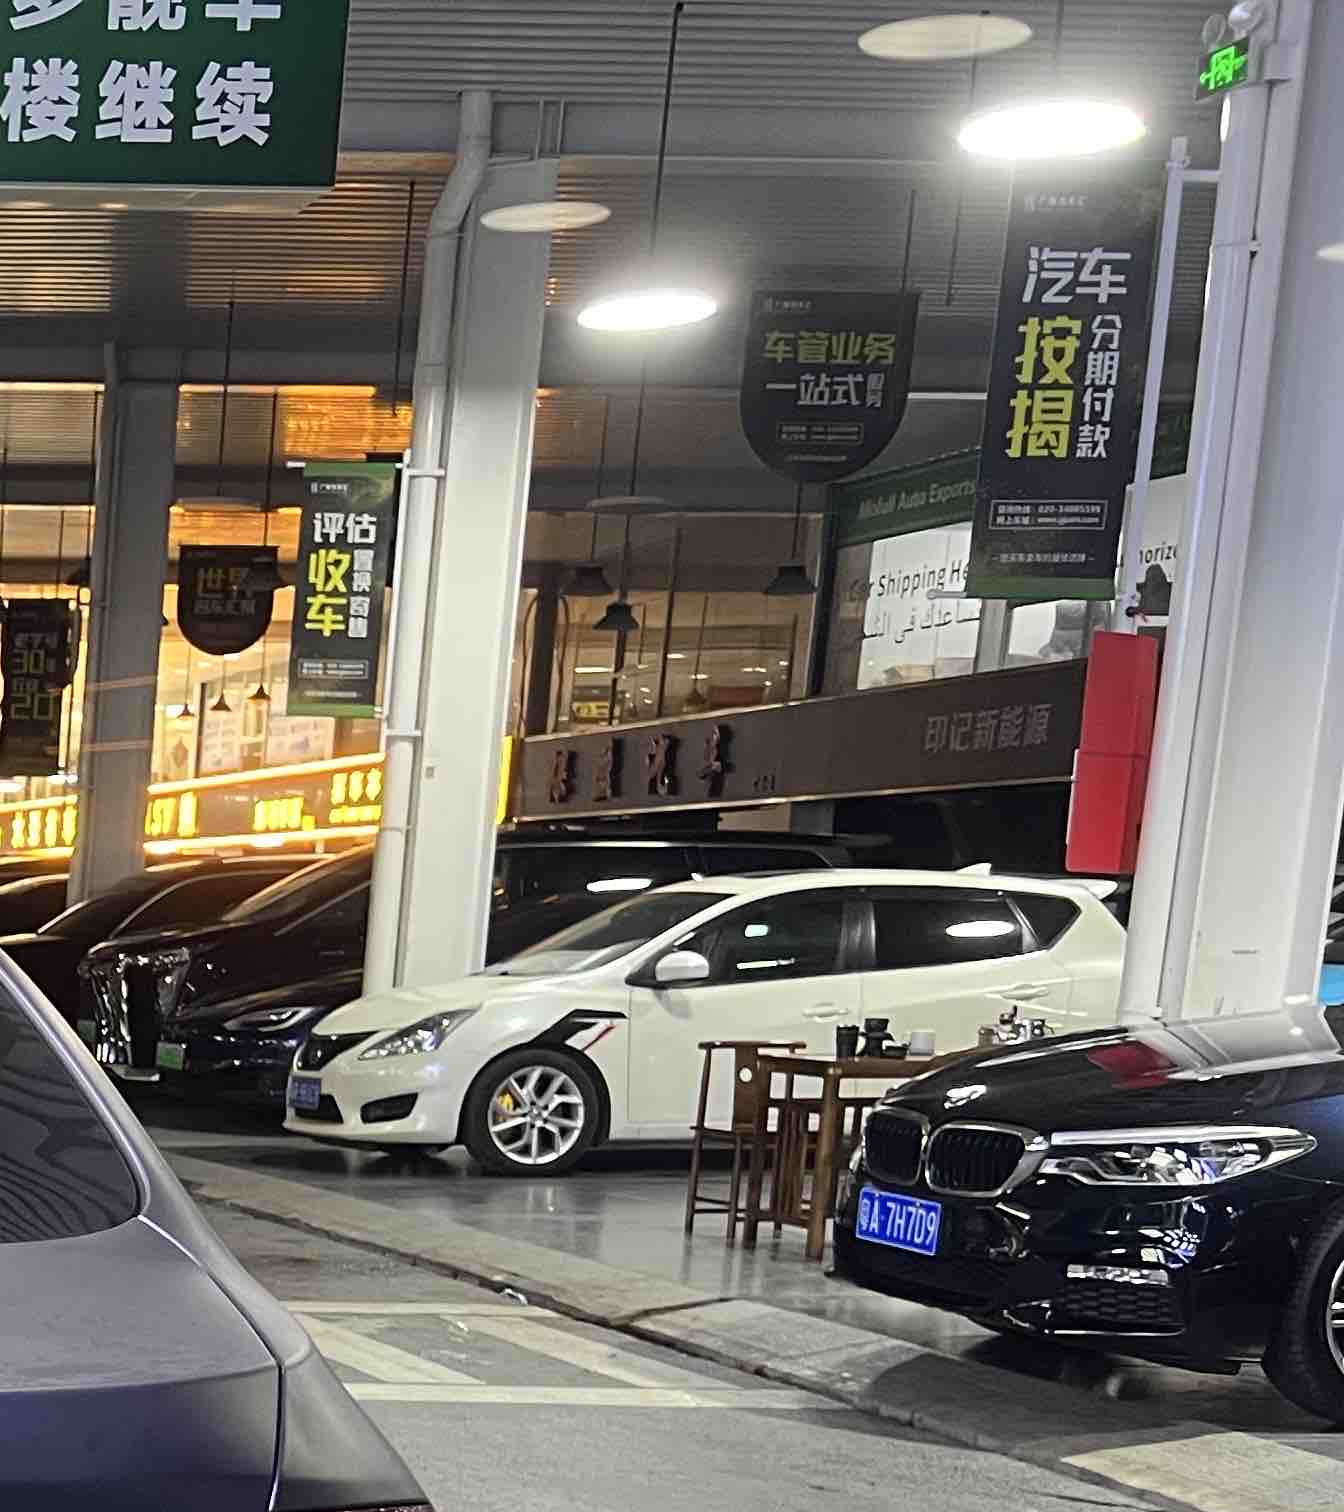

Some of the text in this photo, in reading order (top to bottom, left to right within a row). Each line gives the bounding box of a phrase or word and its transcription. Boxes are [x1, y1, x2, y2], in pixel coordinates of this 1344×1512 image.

[1021, 246, 1133, 304] 汽车
[763, 330, 898, 366] 车管业务
[1004, 315, 1083, 459] 按揭
[1074, 313, 1124, 459] 分期付款
[312, 511, 378, 545] 评估
[304, 548, 352, 638] 收车
[876, 564, 947, 600] Shipping
[924, 703, 1055, 753] 印记新能源
